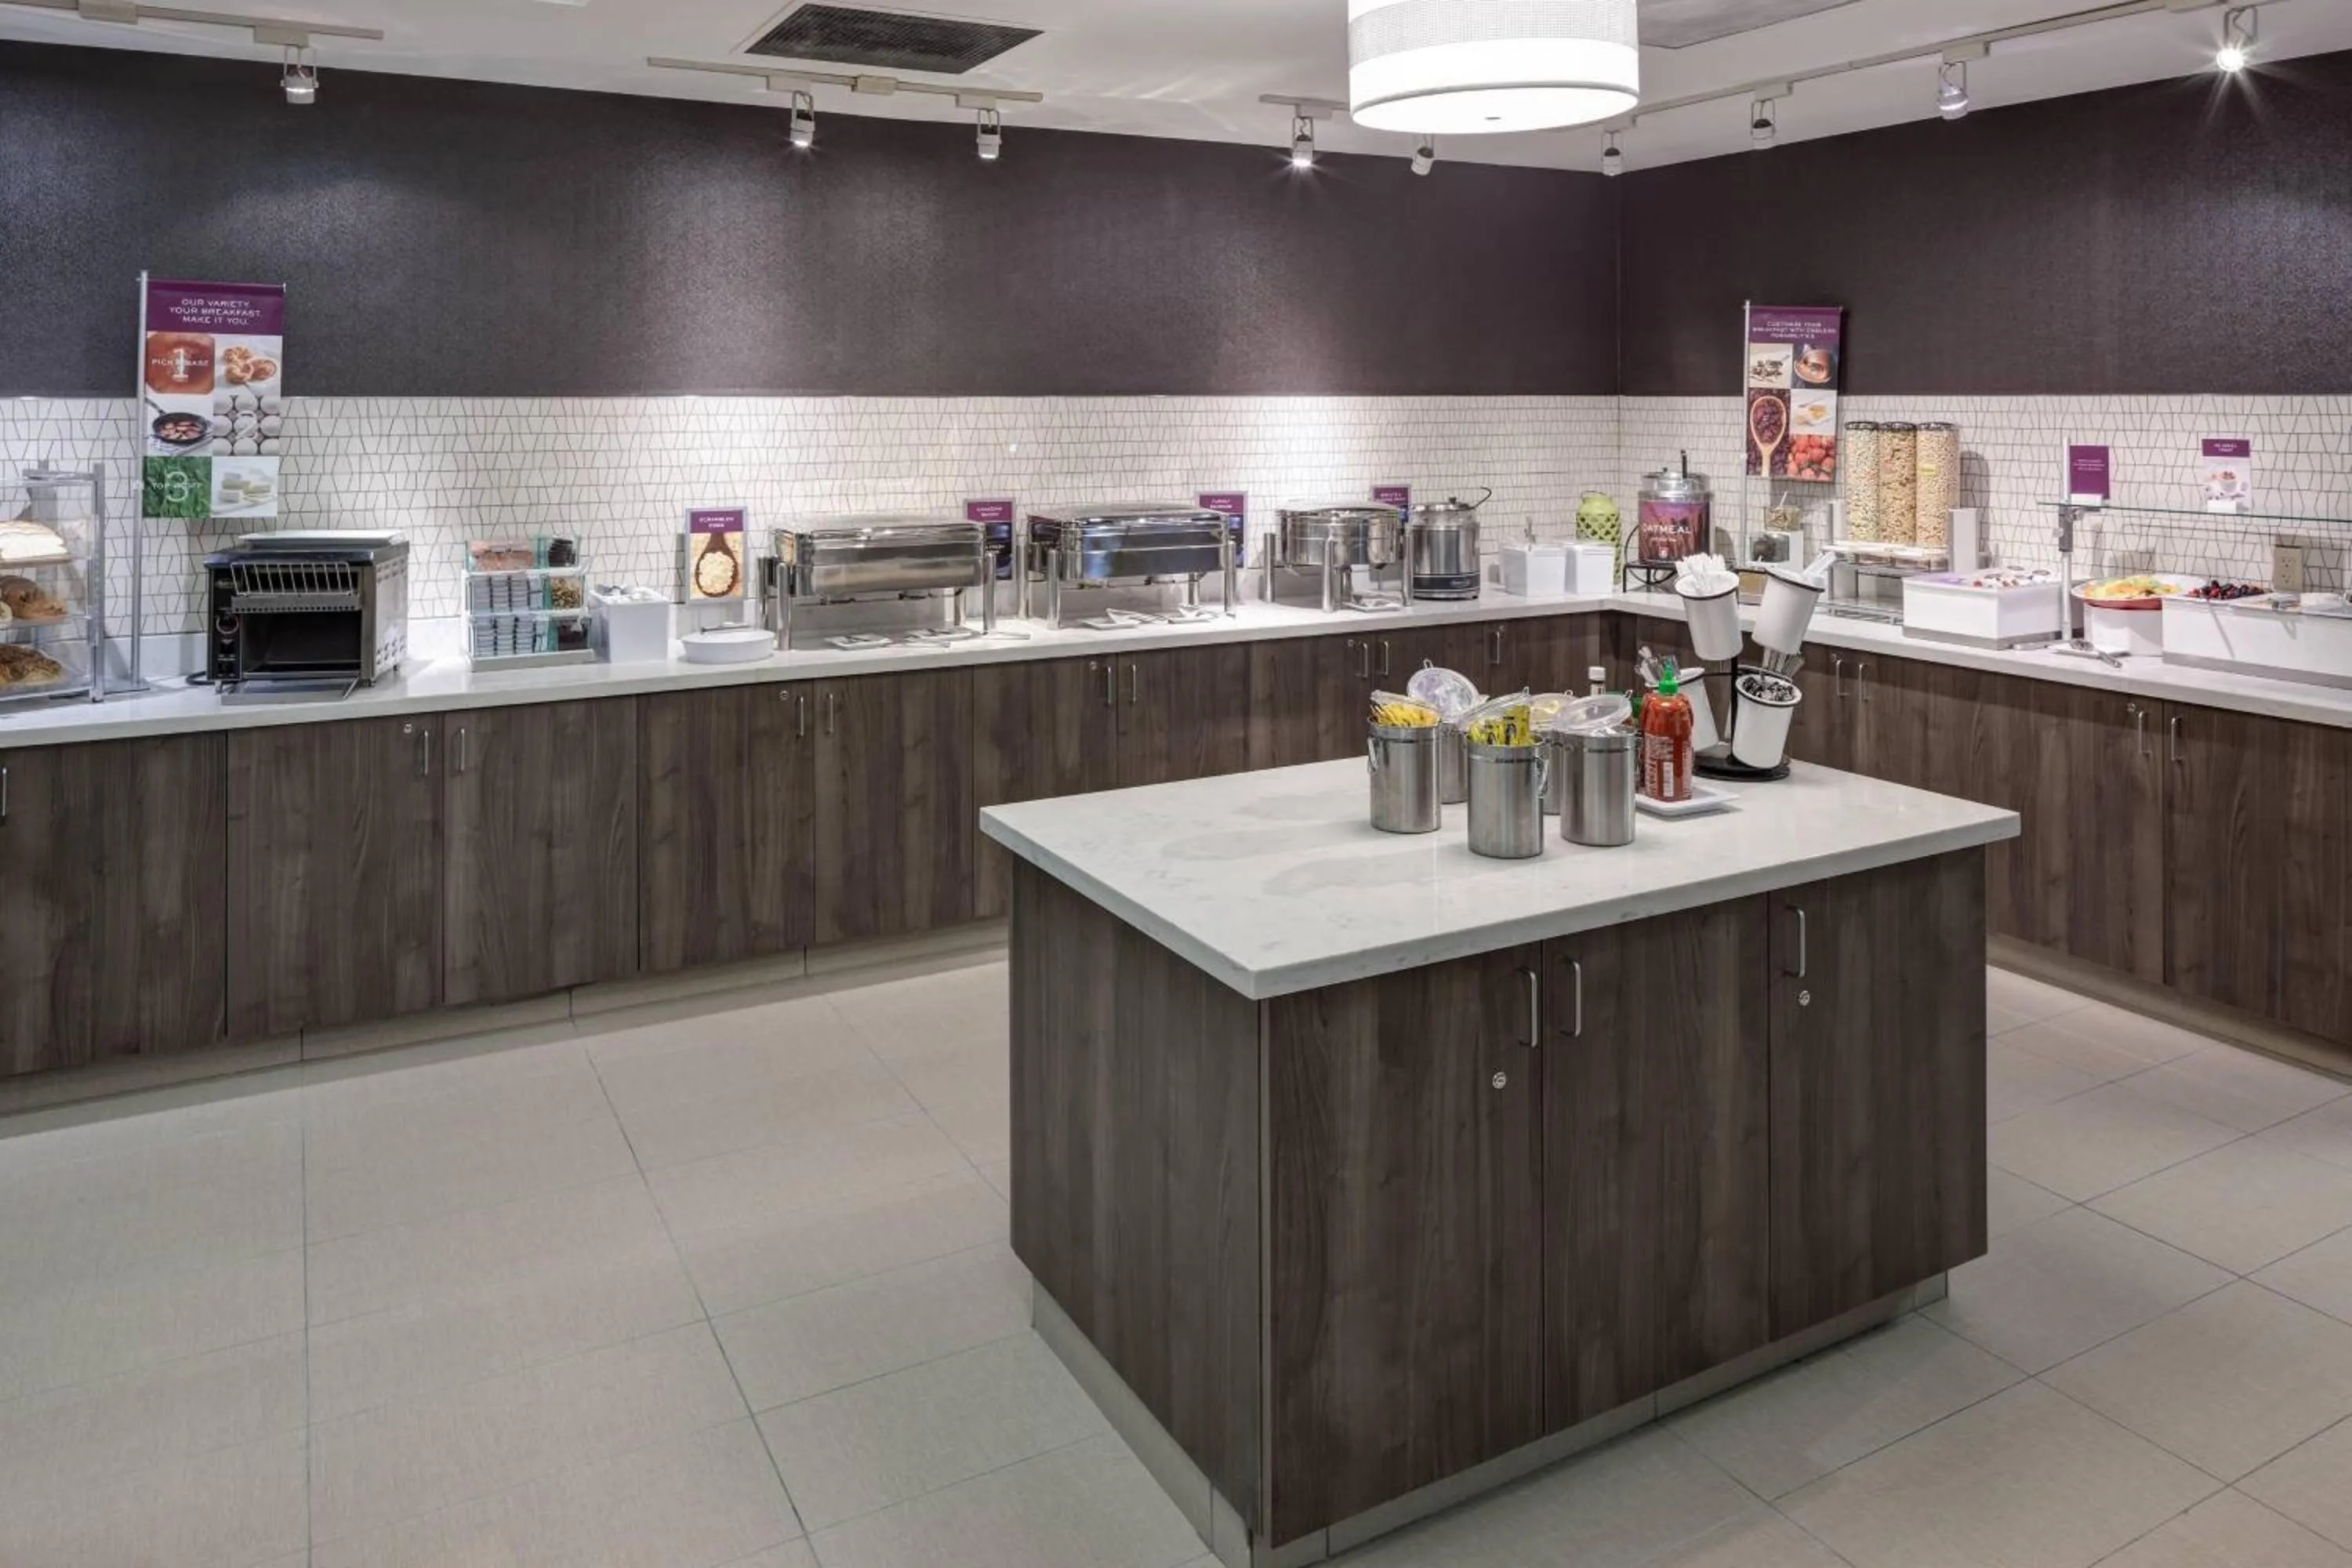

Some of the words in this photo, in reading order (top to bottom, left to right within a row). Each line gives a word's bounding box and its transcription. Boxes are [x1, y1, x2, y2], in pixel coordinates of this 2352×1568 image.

[151, 358, 173, 367] PICK
[172, 347, 189, 380] 1
[164, 471, 189, 503] 3
[1642, 523, 1692, 534] OATMEAL
